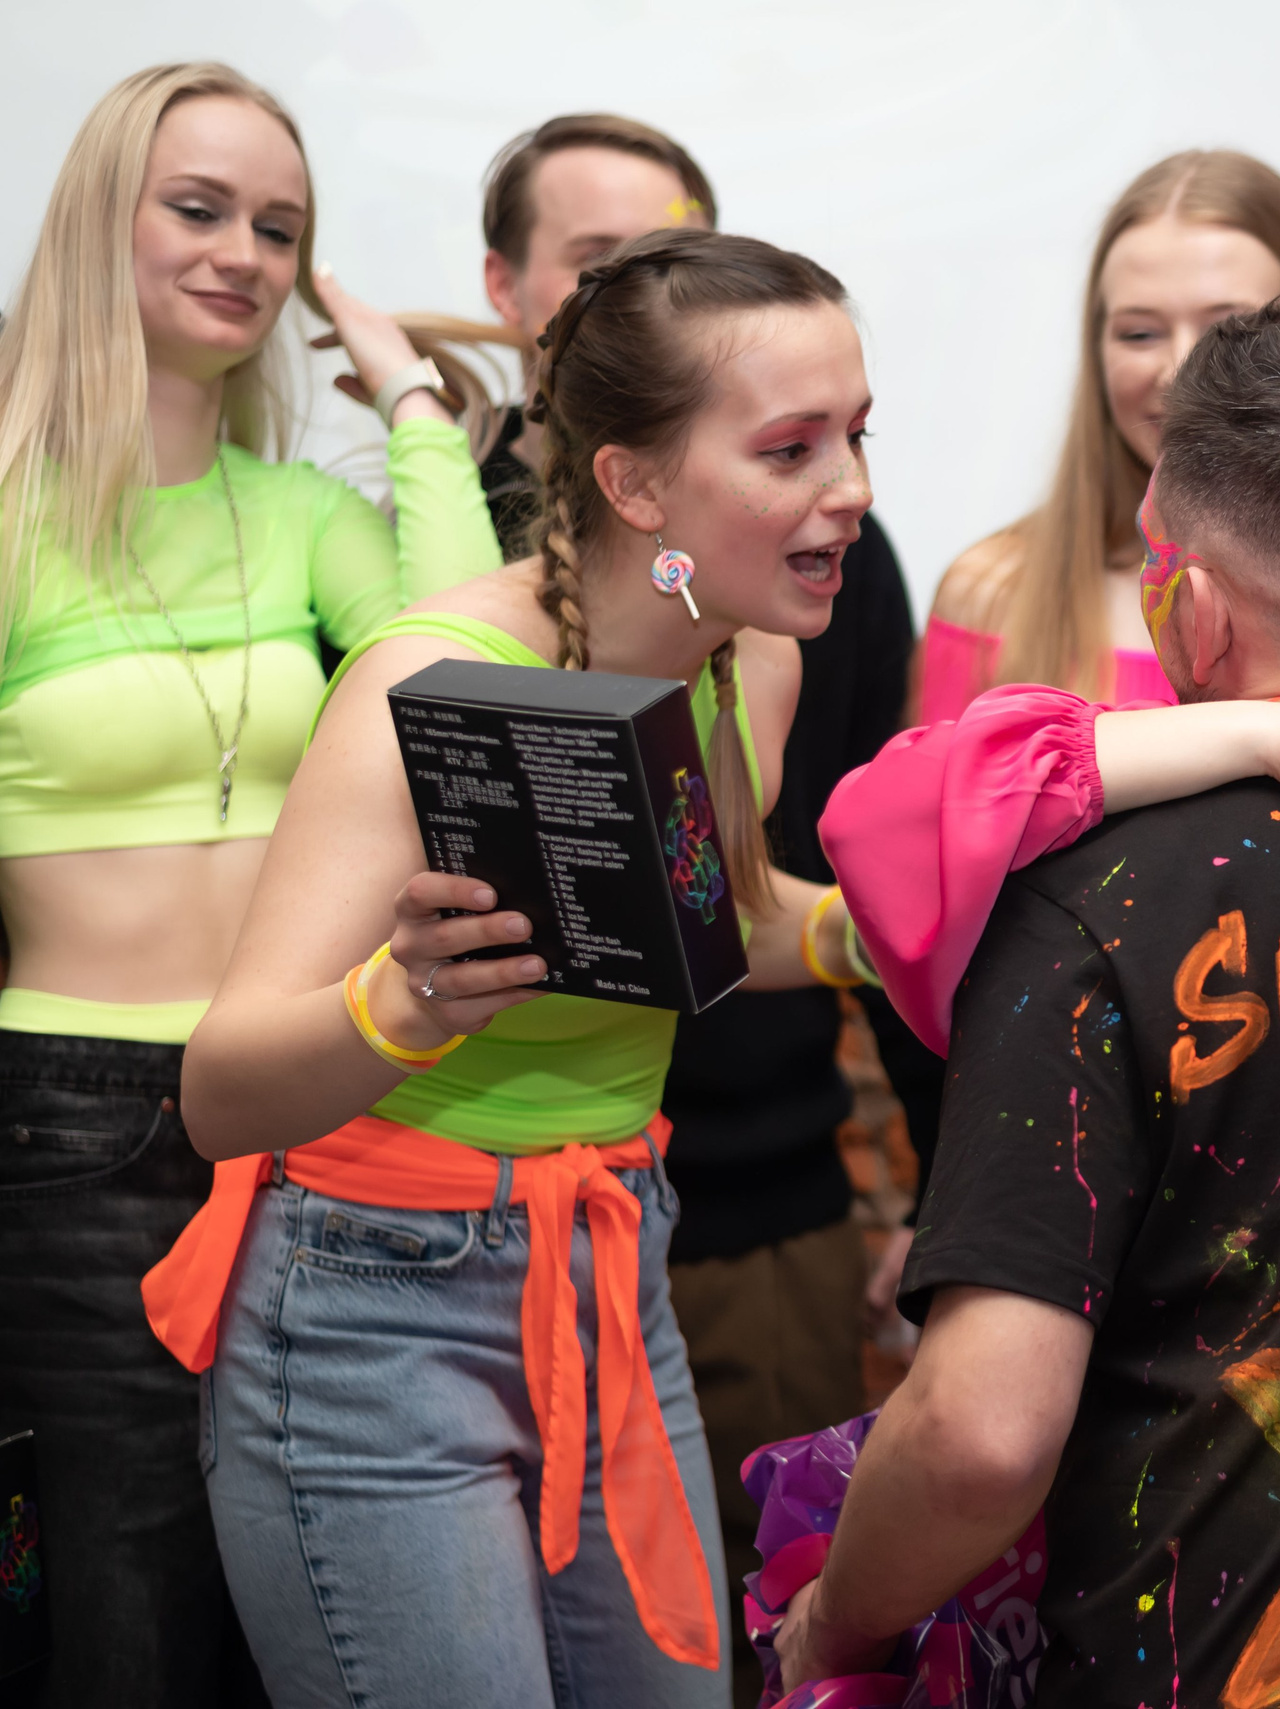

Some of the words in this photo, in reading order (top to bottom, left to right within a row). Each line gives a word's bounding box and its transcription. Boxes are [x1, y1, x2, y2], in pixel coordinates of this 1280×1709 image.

[595, 978, 616, 990] Made
[617, 982, 626, 991] in
[627, 983, 650, 994] China
